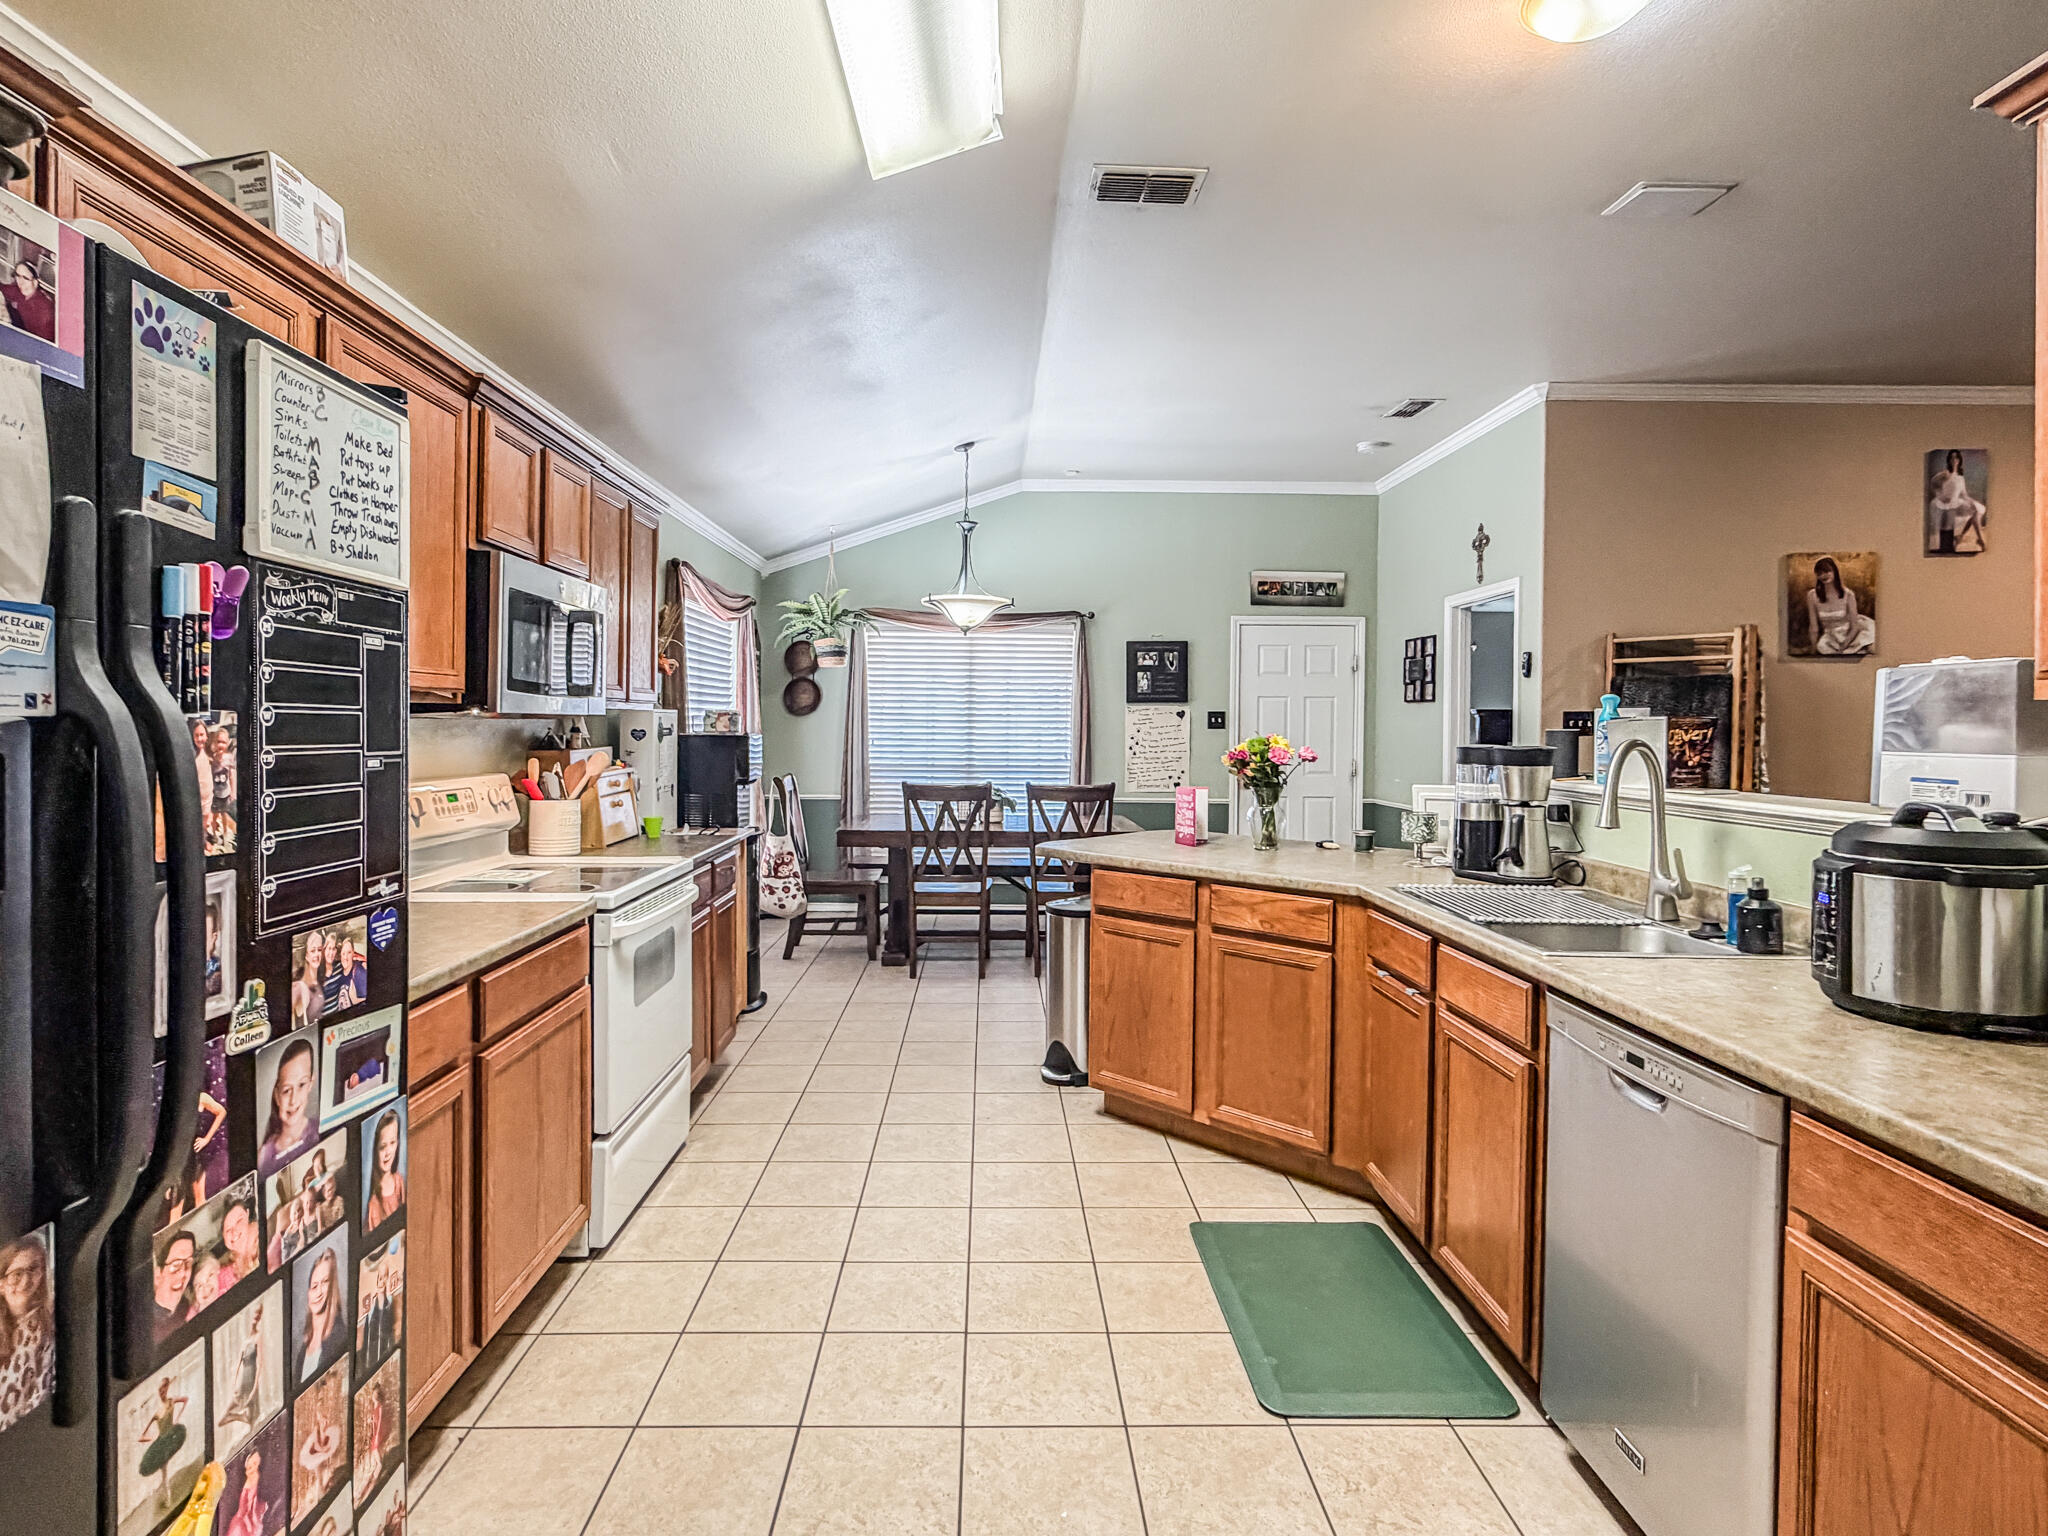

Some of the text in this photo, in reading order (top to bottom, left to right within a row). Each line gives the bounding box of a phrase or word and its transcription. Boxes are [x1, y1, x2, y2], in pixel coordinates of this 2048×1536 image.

[176, 322, 207, 347] 2024
[276, 370, 312, 394] Mirrors
[274, 408, 308, 430] Sinks
[306, 436, 320, 456] M
[345, 432, 393, 458] Make Bed
[309, 455, 320, 470] A
[340, 448, 390, 478] Put toys up
[340, 470, 394, 498] Put books up
[329, 486, 398, 514] Clothes in Hamper
[304, 508, 316, 527] M
[330, 502, 358, 519] Throw
[361, 508, 382, 525] Trash
[304, 528, 316, 550] A
[330, 520, 357, 543] Empty
[330, 539, 337, 554] B
[270, 588, 330, 608] Weekly Menu
[10, 616, 44, 631] EZ-CARE
[265, 796, 272, 808] F
[234, 1031, 264, 1048] Colleen
[338, 1020, 370, 1038] Precious
